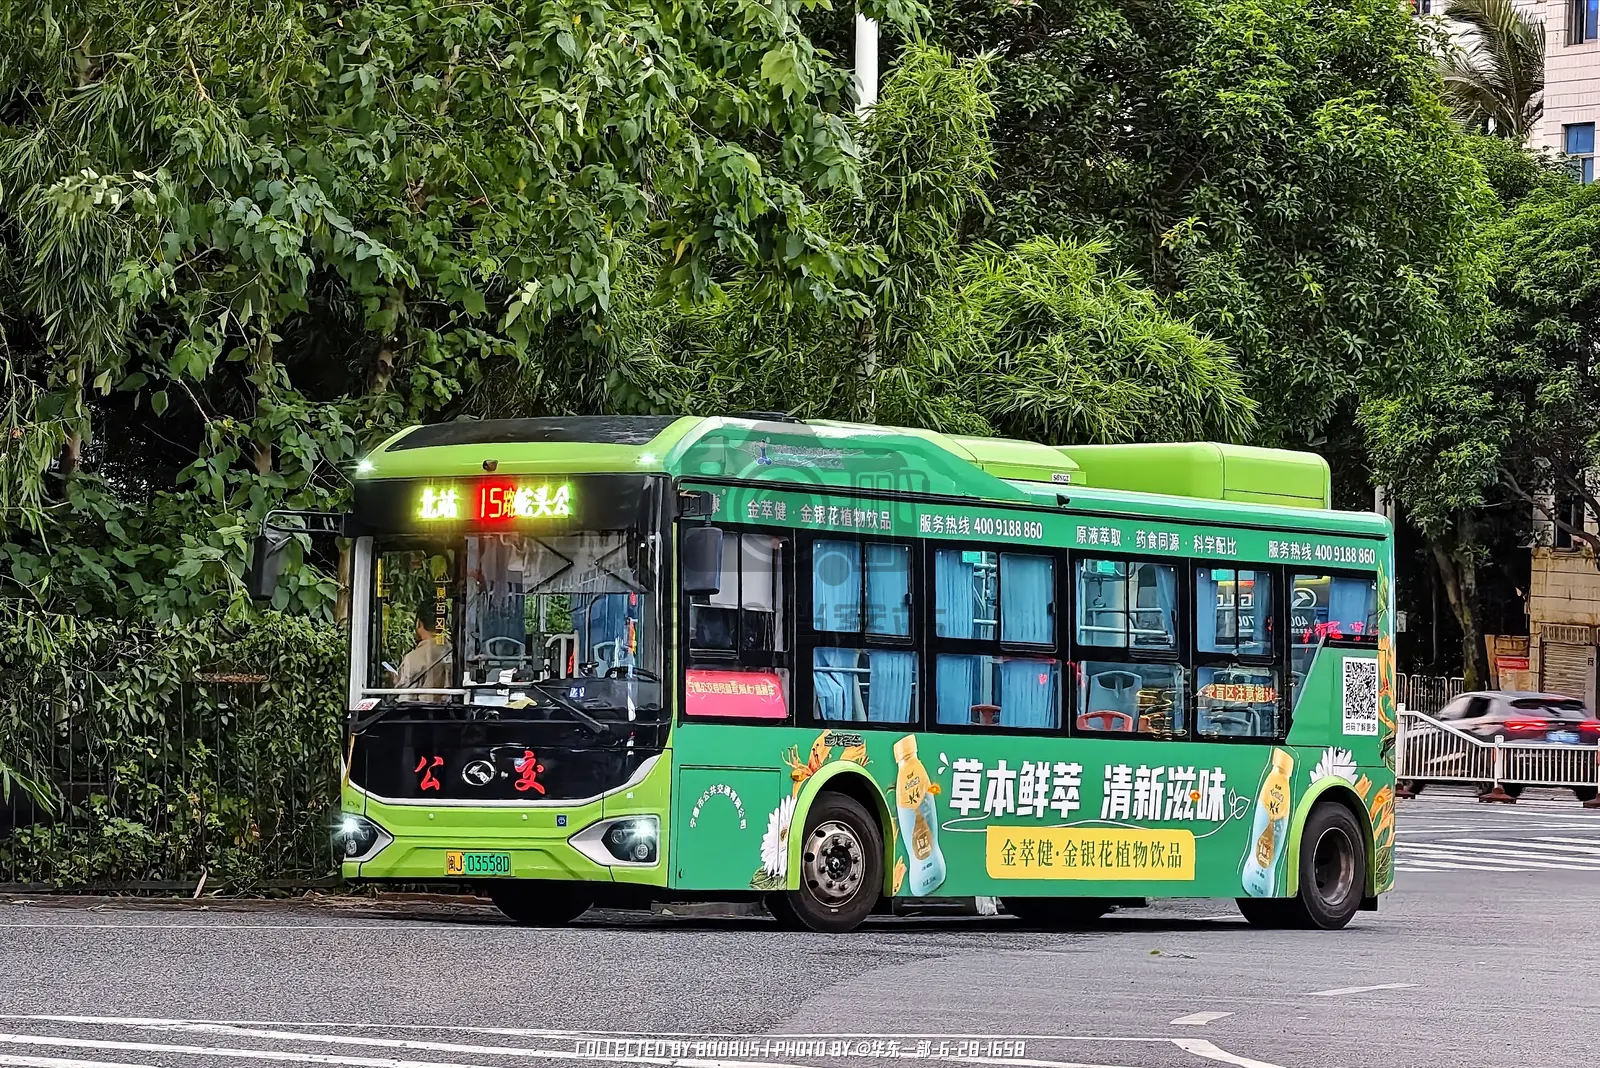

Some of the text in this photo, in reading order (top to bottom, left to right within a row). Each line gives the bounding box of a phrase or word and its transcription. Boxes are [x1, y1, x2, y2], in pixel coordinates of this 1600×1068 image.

[919, 513, 1043, 539] 服务热线 400 9188 860
[1268, 540, 1376, 565] 服务热线 400 9188 860
[414, 750, 545, 795] 公 交
[949, 758, 1082, 819] 草本鲜萃
[1100, 764, 1226, 822] 清新滋味
